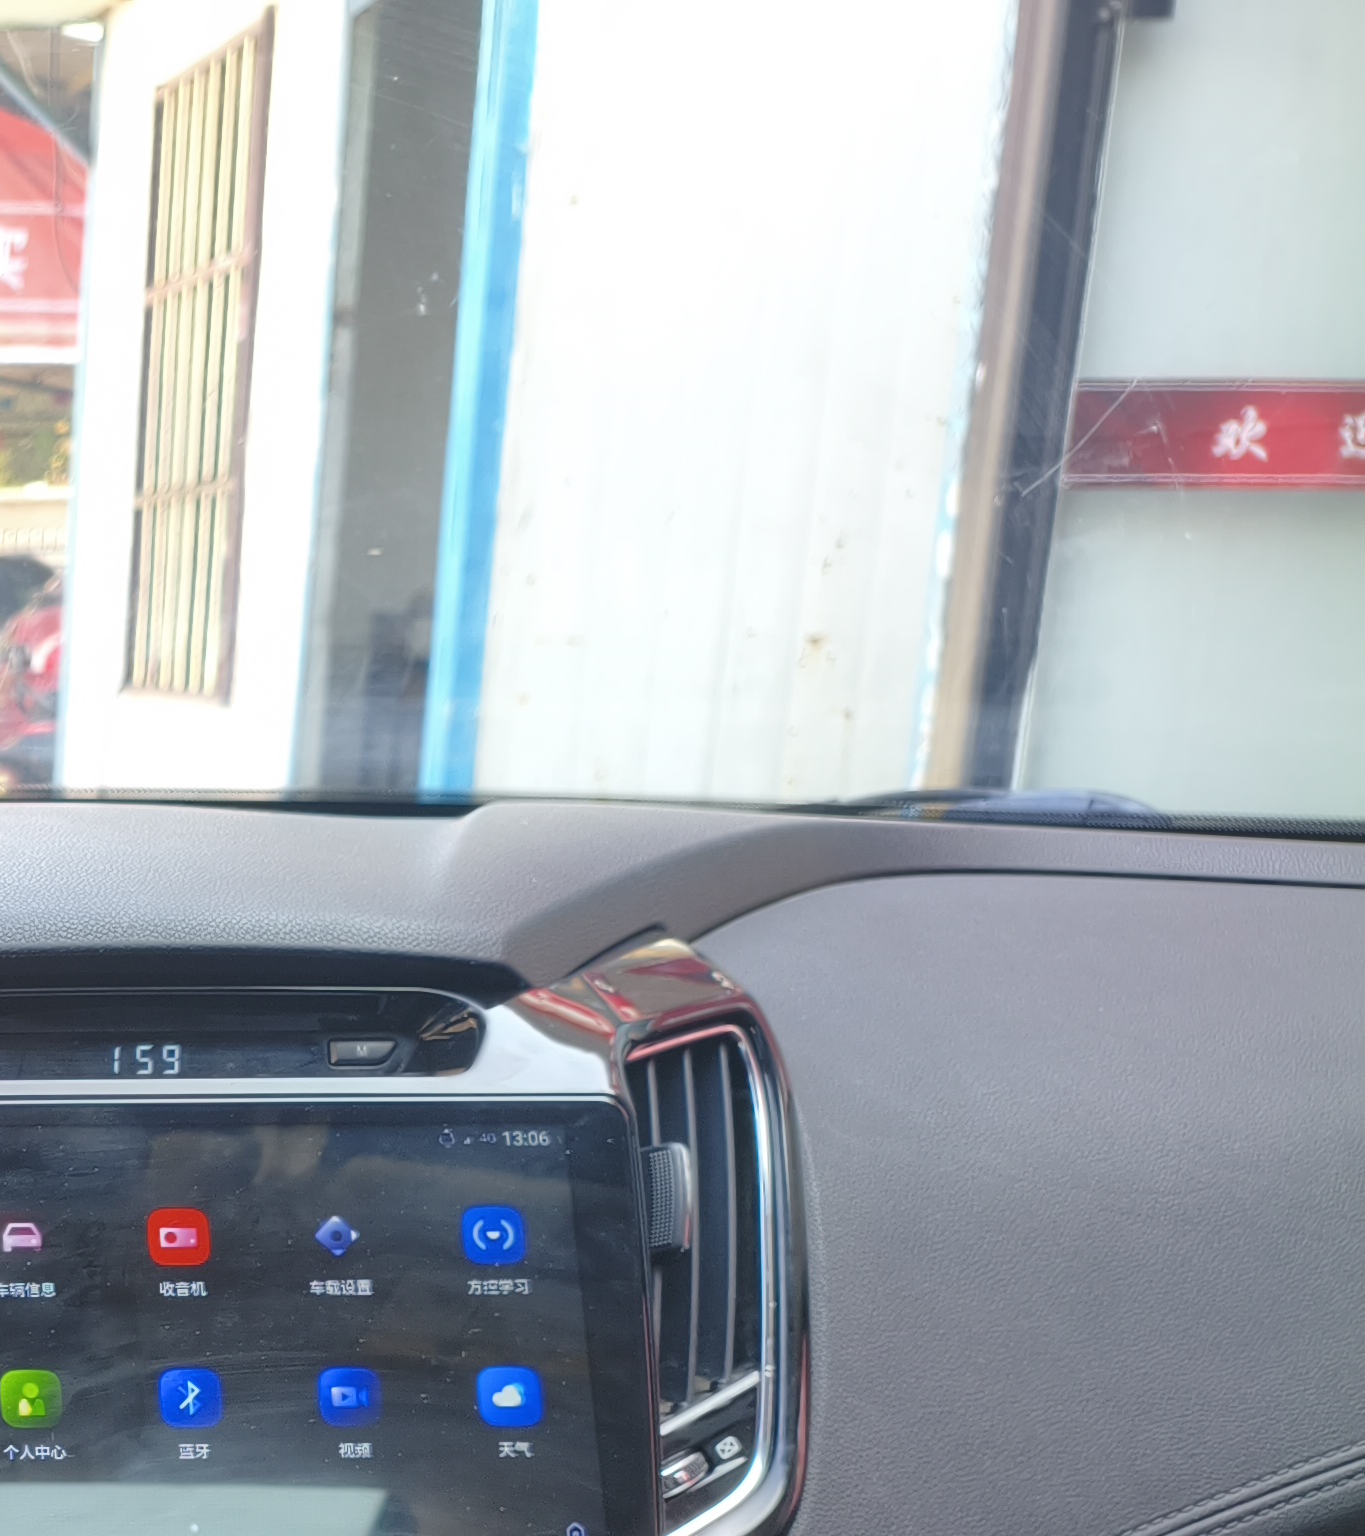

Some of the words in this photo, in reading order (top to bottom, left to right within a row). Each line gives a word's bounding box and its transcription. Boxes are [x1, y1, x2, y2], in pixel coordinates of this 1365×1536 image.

[501, 1130, 550, 1147] 13:06
[159, 1281, 207, 1297] 收音机
[310, 1279, 374, 1296] 车载设置
[467, 1279, 531, 1295] 方控学习
[3, 1444, 68, 1460] 个人中心
[178, 1443, 211, 1459] 蓝牙
[338, 1442, 373, 1459] 视频
[498, 1441, 534, 1458] 天气
